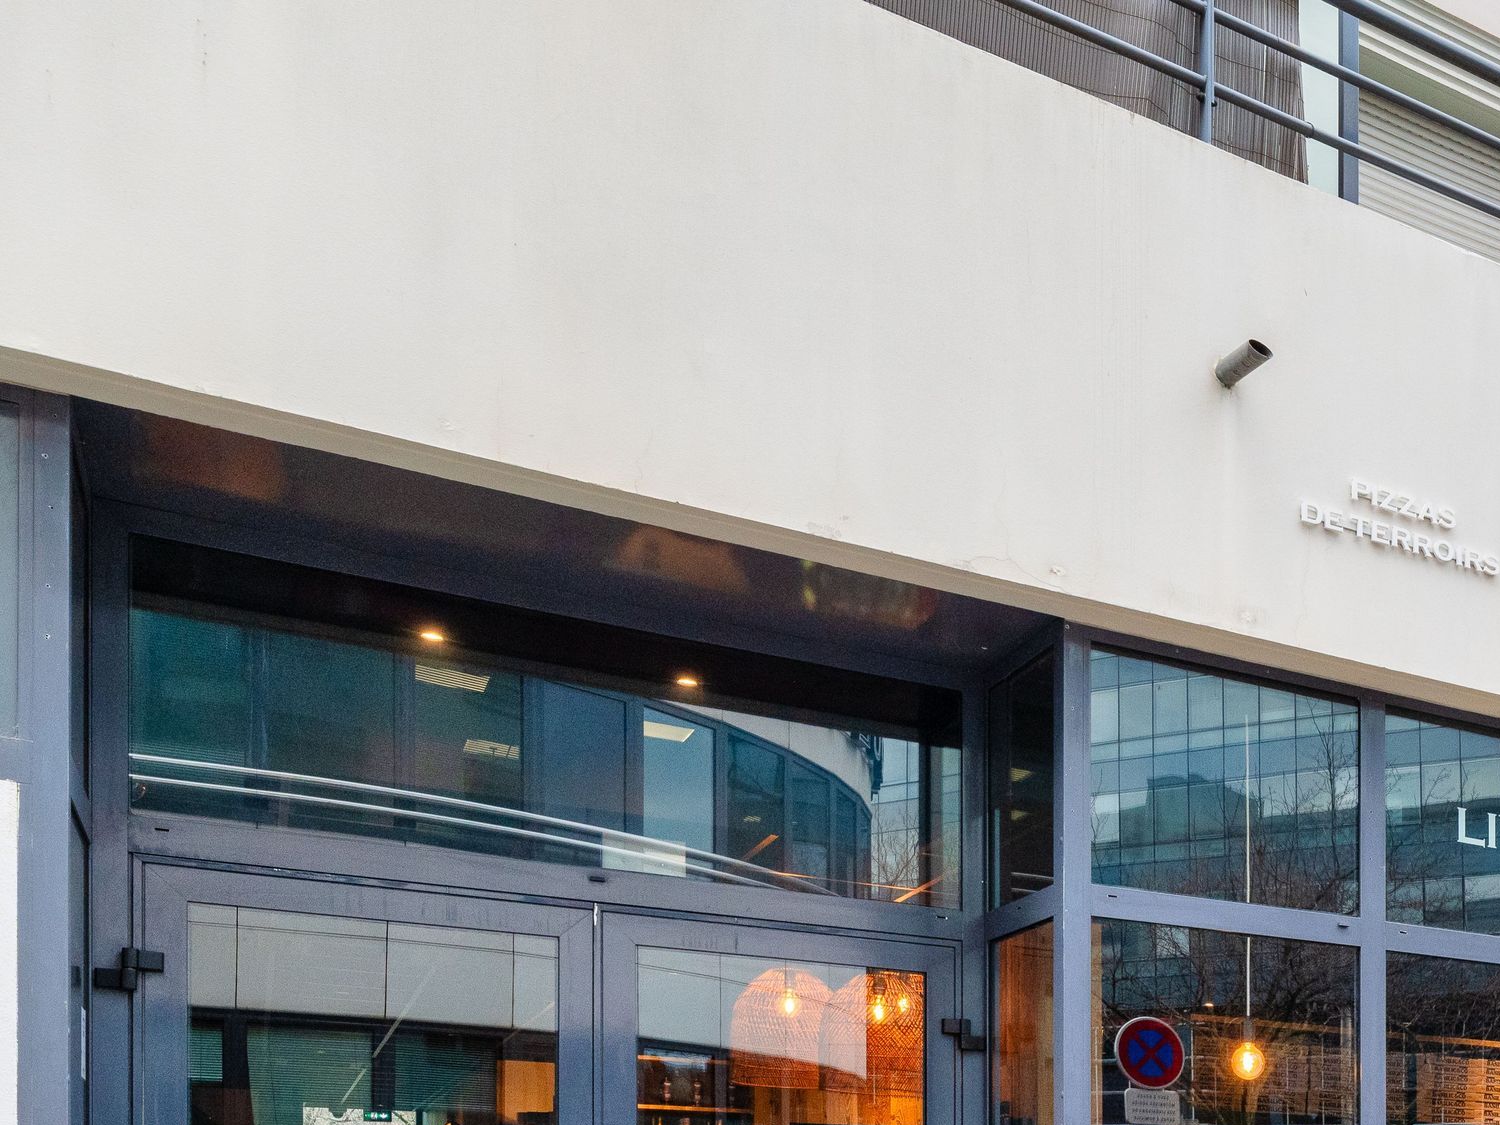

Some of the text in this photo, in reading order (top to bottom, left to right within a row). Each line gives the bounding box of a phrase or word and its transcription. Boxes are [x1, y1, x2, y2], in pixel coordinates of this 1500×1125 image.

[1350, 477, 1457, 529] PIZZAS
[1299, 500, 1500, 576] DE TERROIRS
